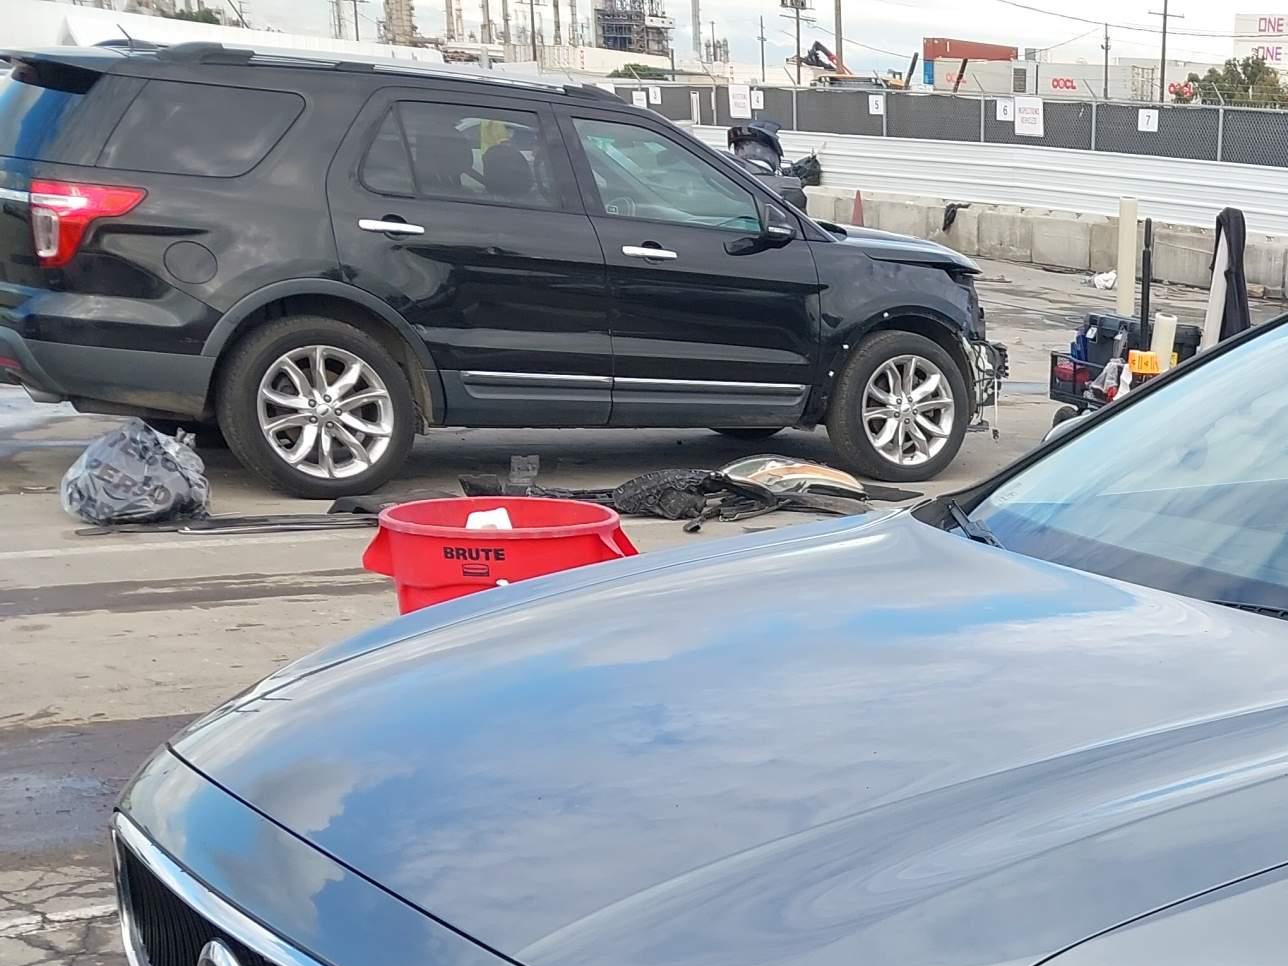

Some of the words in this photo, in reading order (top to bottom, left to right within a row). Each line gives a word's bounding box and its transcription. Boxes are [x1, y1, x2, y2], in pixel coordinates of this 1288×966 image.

[1258, 17, 1284, 32] ONE
[1257, 46, 1282, 61] ONE
[1051, 78, 1077, 90] OOCL
[874, 99, 880, 110] 5
[1002, 105, 1008, 116] 6
[1145, 114, 1151, 126] 7
[443, 546, 506, 562] BRUTE
